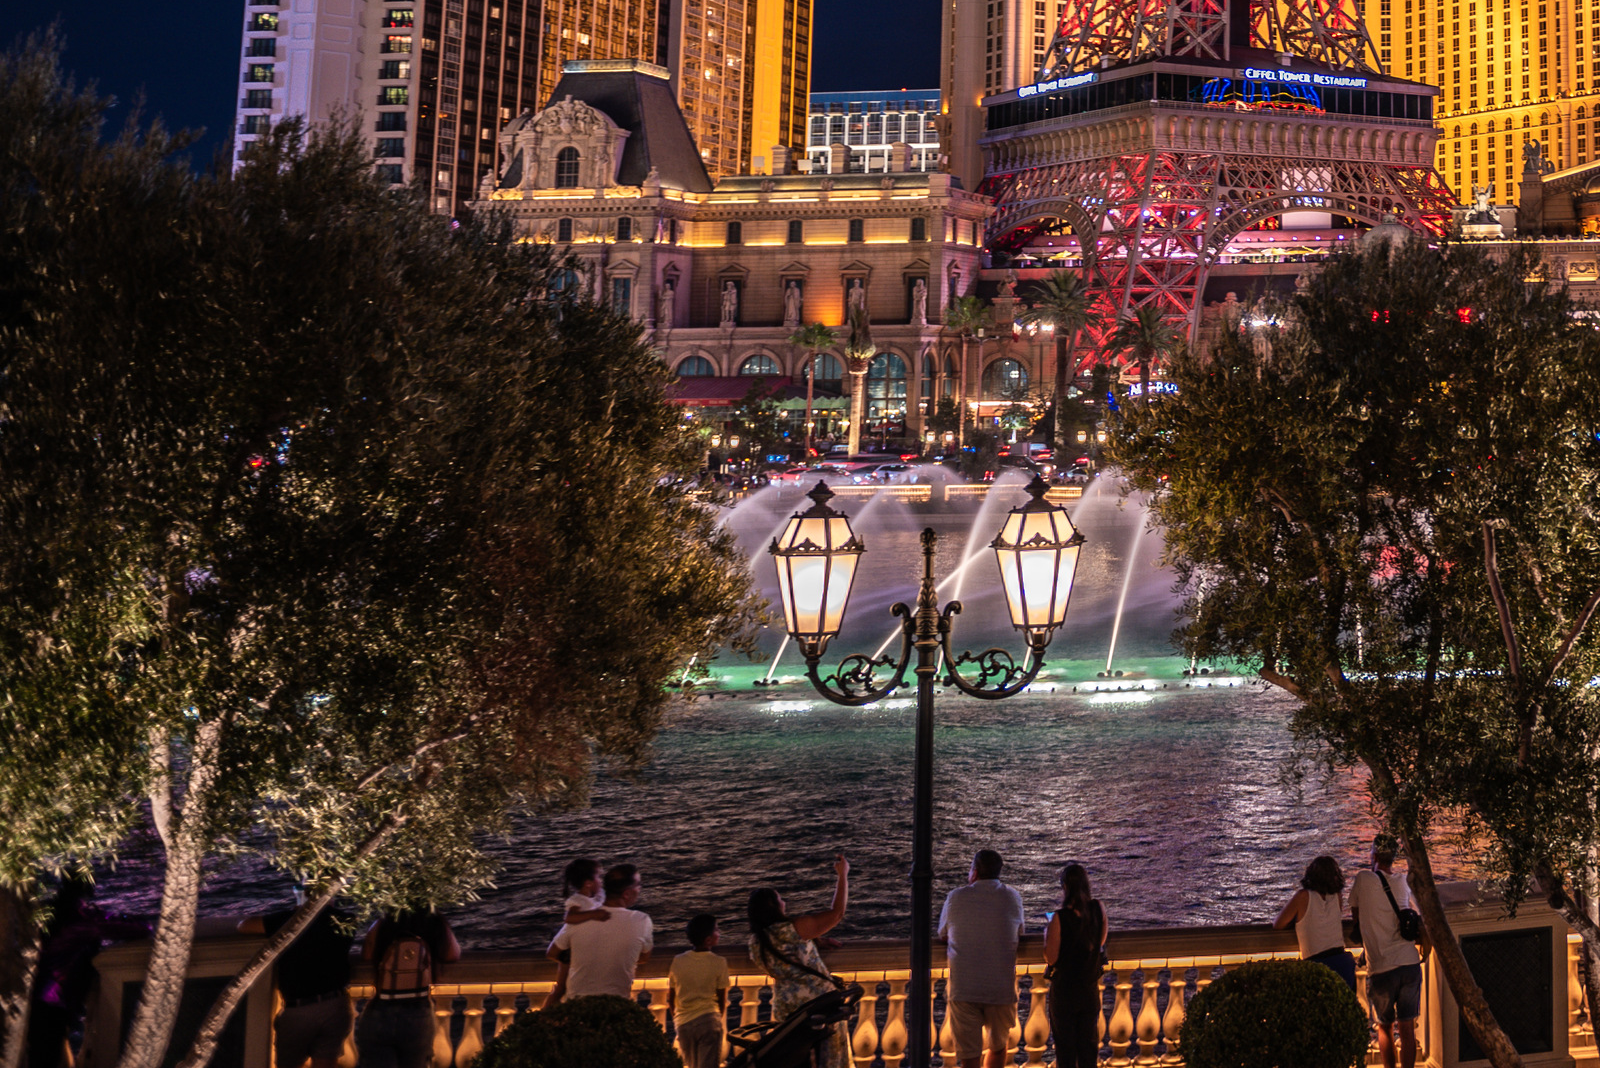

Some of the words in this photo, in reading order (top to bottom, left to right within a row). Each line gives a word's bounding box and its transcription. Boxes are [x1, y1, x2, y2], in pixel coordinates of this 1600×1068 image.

[1245, 68, 1277, 81] EIFFEL
[1278, 70, 1311, 83] TOWER
[1313, 74, 1367, 88] RESTAURANT
